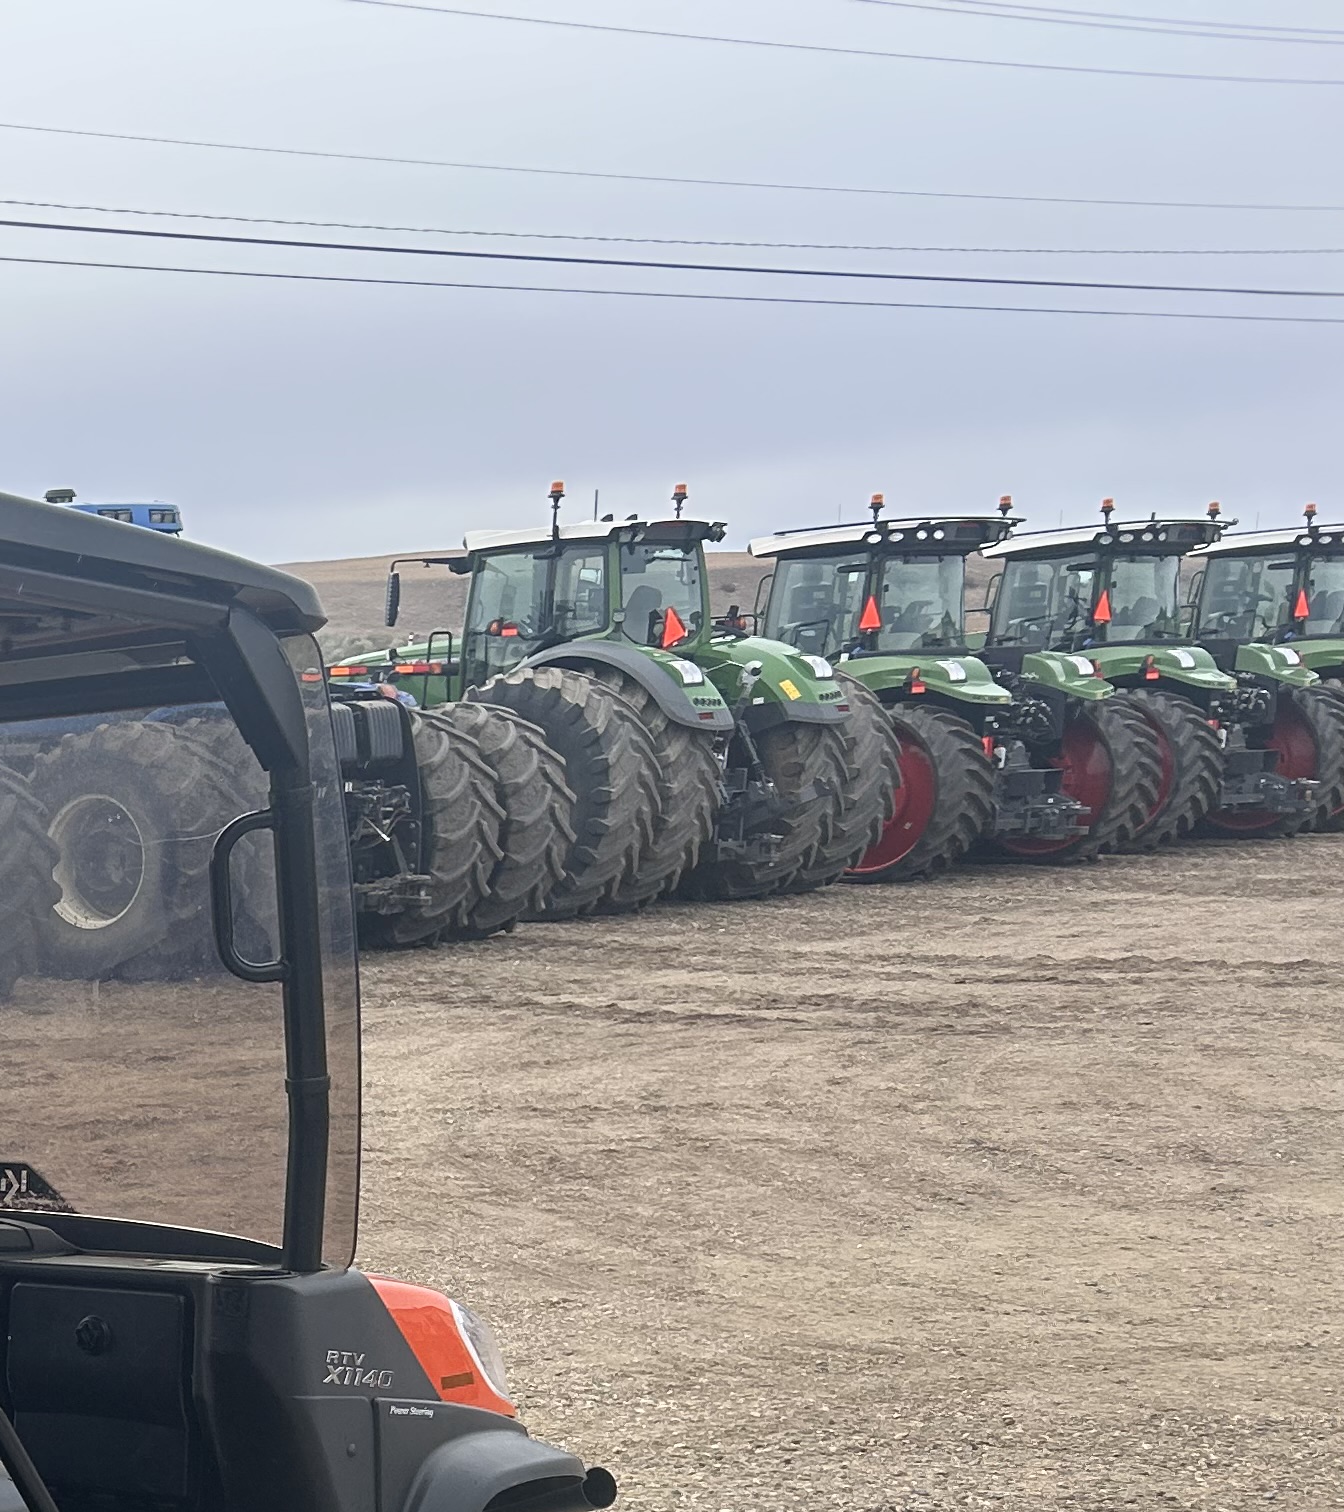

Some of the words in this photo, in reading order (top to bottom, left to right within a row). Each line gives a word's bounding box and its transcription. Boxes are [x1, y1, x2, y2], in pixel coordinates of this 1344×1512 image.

[326, 1350, 365, 1366] RTV
[323, 1365, 395, 1389] X1140
[389, 1405, 410, 1415] Power
[409, 1406, 434, 1419] Steering
